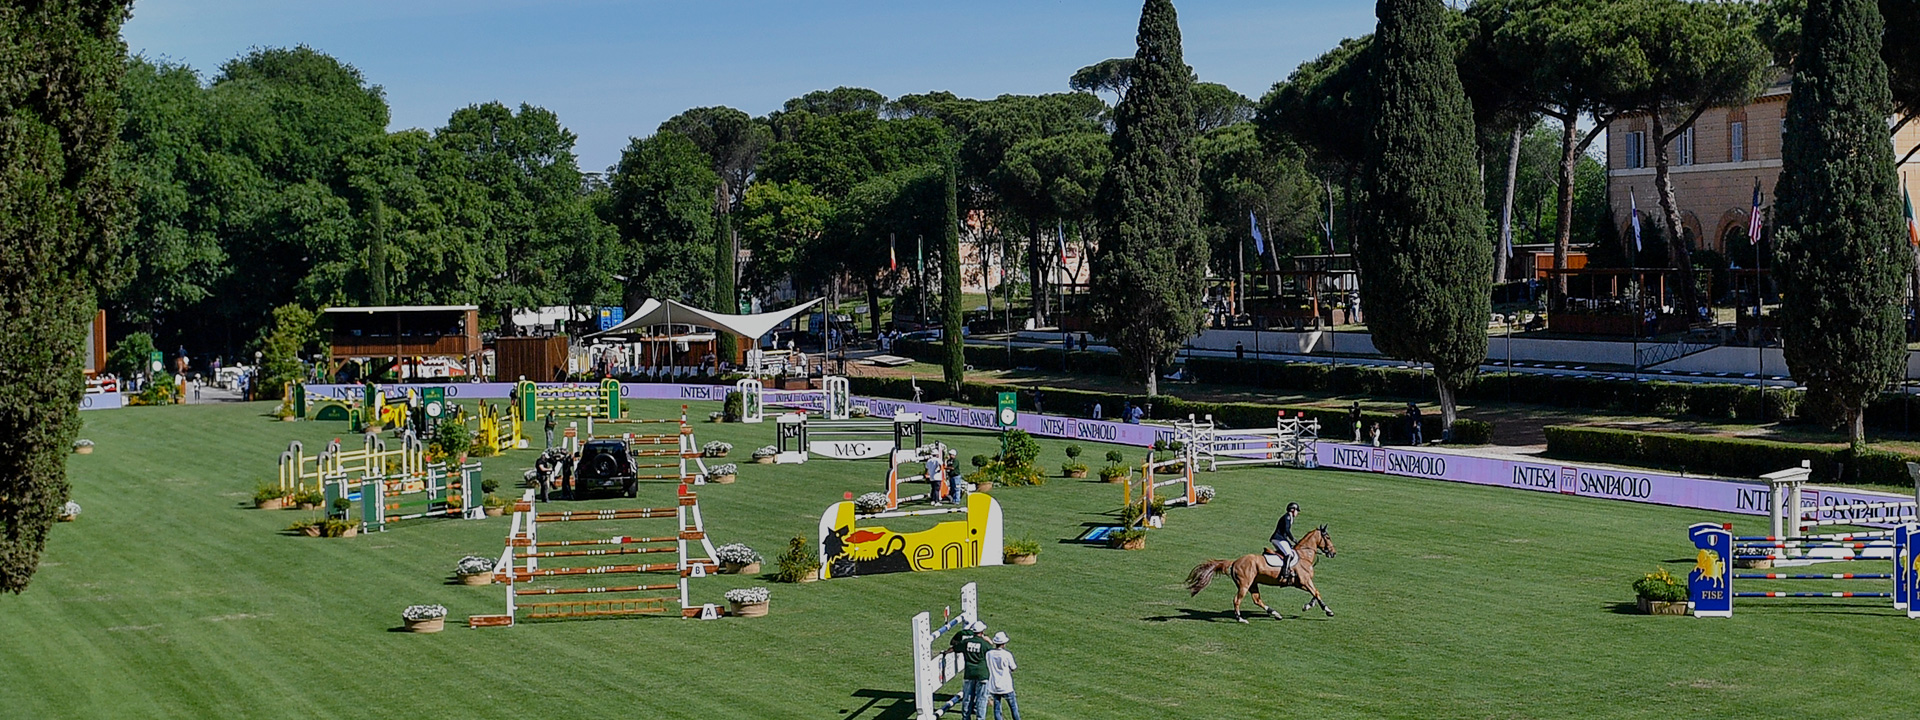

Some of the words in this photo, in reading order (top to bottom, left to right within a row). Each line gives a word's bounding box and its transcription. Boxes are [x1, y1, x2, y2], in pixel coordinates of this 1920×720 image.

[680, 386, 711, 399] INTESA
[937, 408, 960, 424] INTESA
[1040, 418, 1065, 436] INTESA
[1077, 422, 1117, 441] SANPAOLO
[1333, 447, 1369, 469] INTESA
[1388, 453, 1446, 476] SANPAOLO
[1512, 466, 1557, 489] INTESA
[1579, 472, 1652, 499] SANPAOLO
[913, 528, 978, 570] eni
[695, 566, 701, 574] B
[1701, 590, 1724, 600] FISE
[705, 608, 713, 617] A
